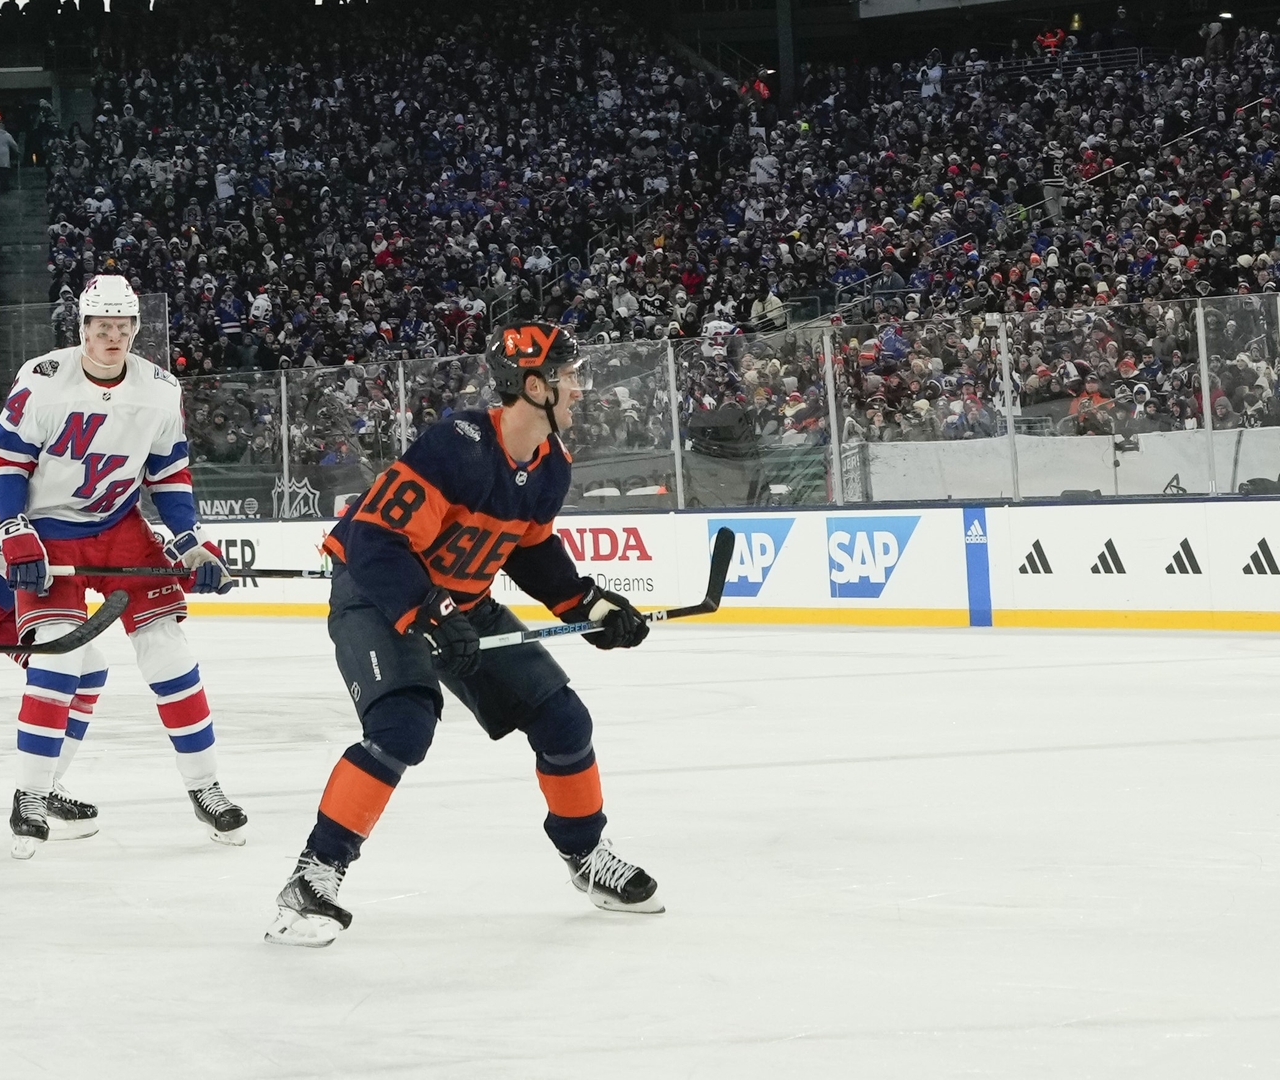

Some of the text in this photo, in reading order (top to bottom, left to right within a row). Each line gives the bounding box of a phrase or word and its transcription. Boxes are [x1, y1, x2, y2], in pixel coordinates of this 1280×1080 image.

[198, 500, 243, 515] NAVY
[363, 468, 426, 530] 18
[965, 535, 987, 544] adidas
[828, 530, 900, 584] SAP
[596, 574, 654, 593] Dreams
[368, 650, 382, 682] BAUER
